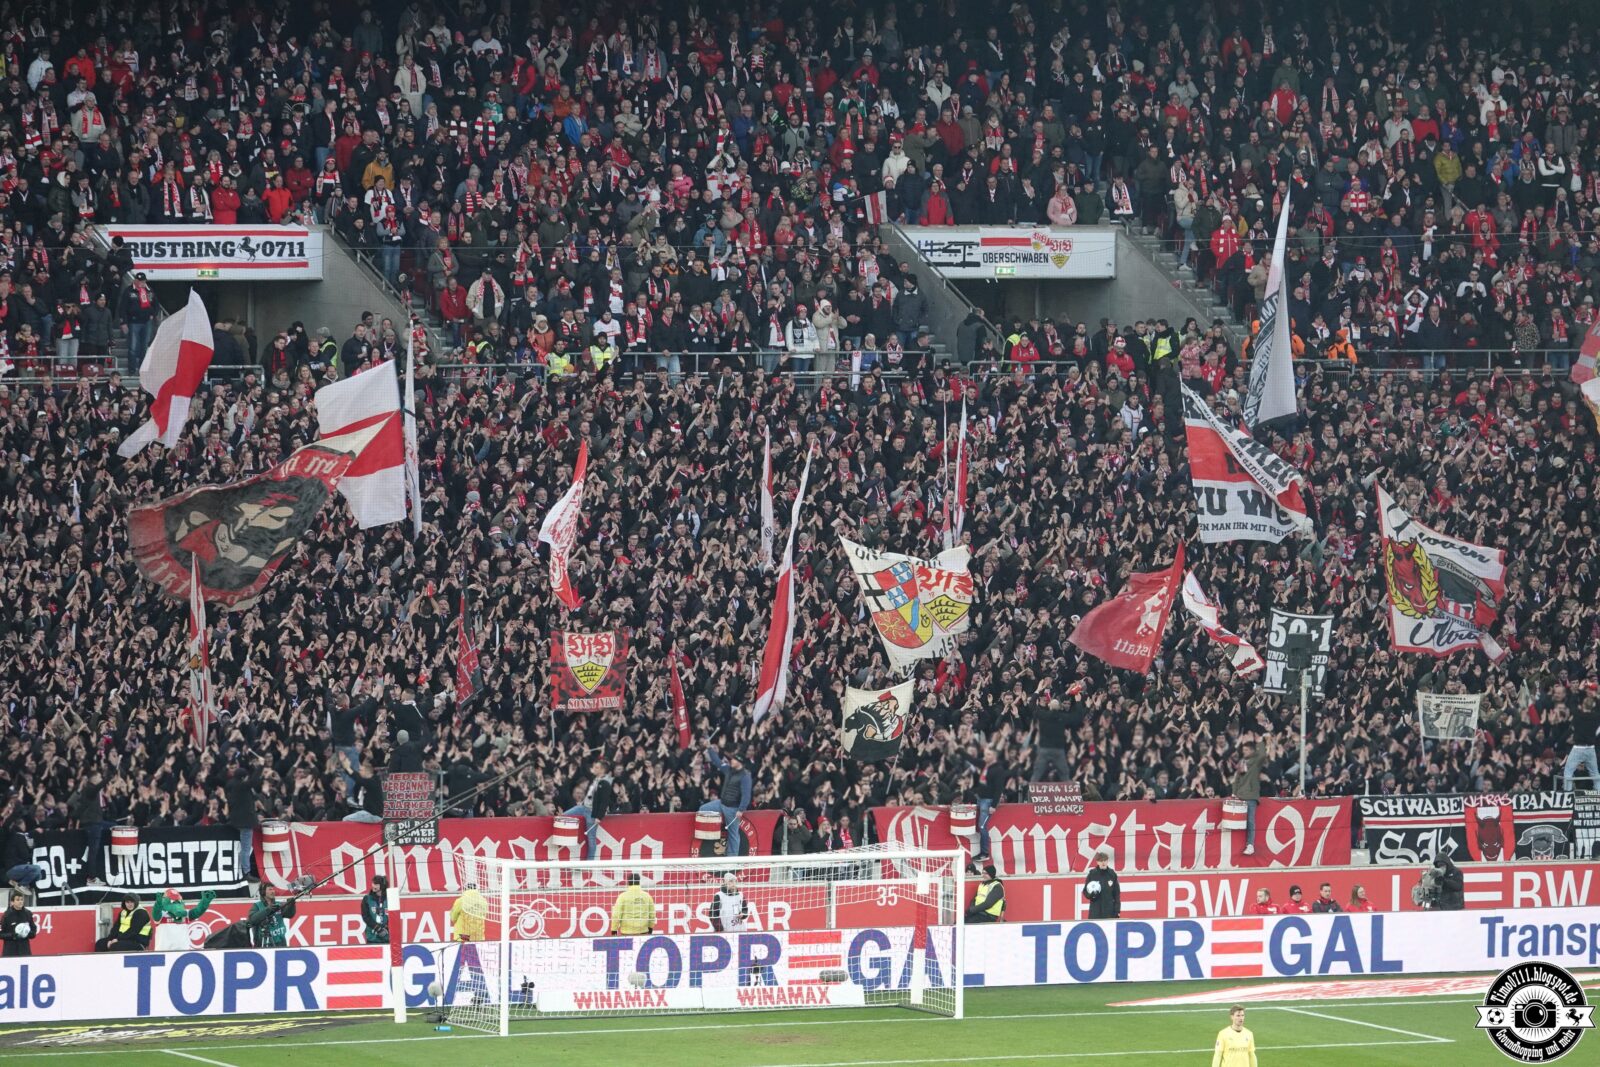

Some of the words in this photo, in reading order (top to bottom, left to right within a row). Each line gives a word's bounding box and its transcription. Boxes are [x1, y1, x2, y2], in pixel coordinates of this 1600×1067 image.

[128, 239, 236, 259] RUSTRING
[261, 239, 306, 258] 0711
[982, 252, 1049, 264] OBERSCHWABEN
[1211, 522, 1232, 531] MAN
[1232, 521, 1248, 531] IHN
[1250, 522, 1268, 532] MIT
[383, 781, 435, 791] VERBANNTE
[1028, 784, 1061, 793] ULTRA
[1064, 784, 1080, 793] IST
[387, 792, 429, 800] KEHRT
[1033, 805, 1053, 814] UMS
[1054, 804, 1084, 814] GANZE
[397, 820, 411, 830] DU
[1264, 804, 1341, 868] 97
[32, 845, 90, 890] 50+
[876, 886, 898, 907] 35
[1022, 914, 1403, 984] TOPREGAL
[573, 989, 669, 1010] WINAMAX
[736, 985, 831, 1006] WINAMAX
